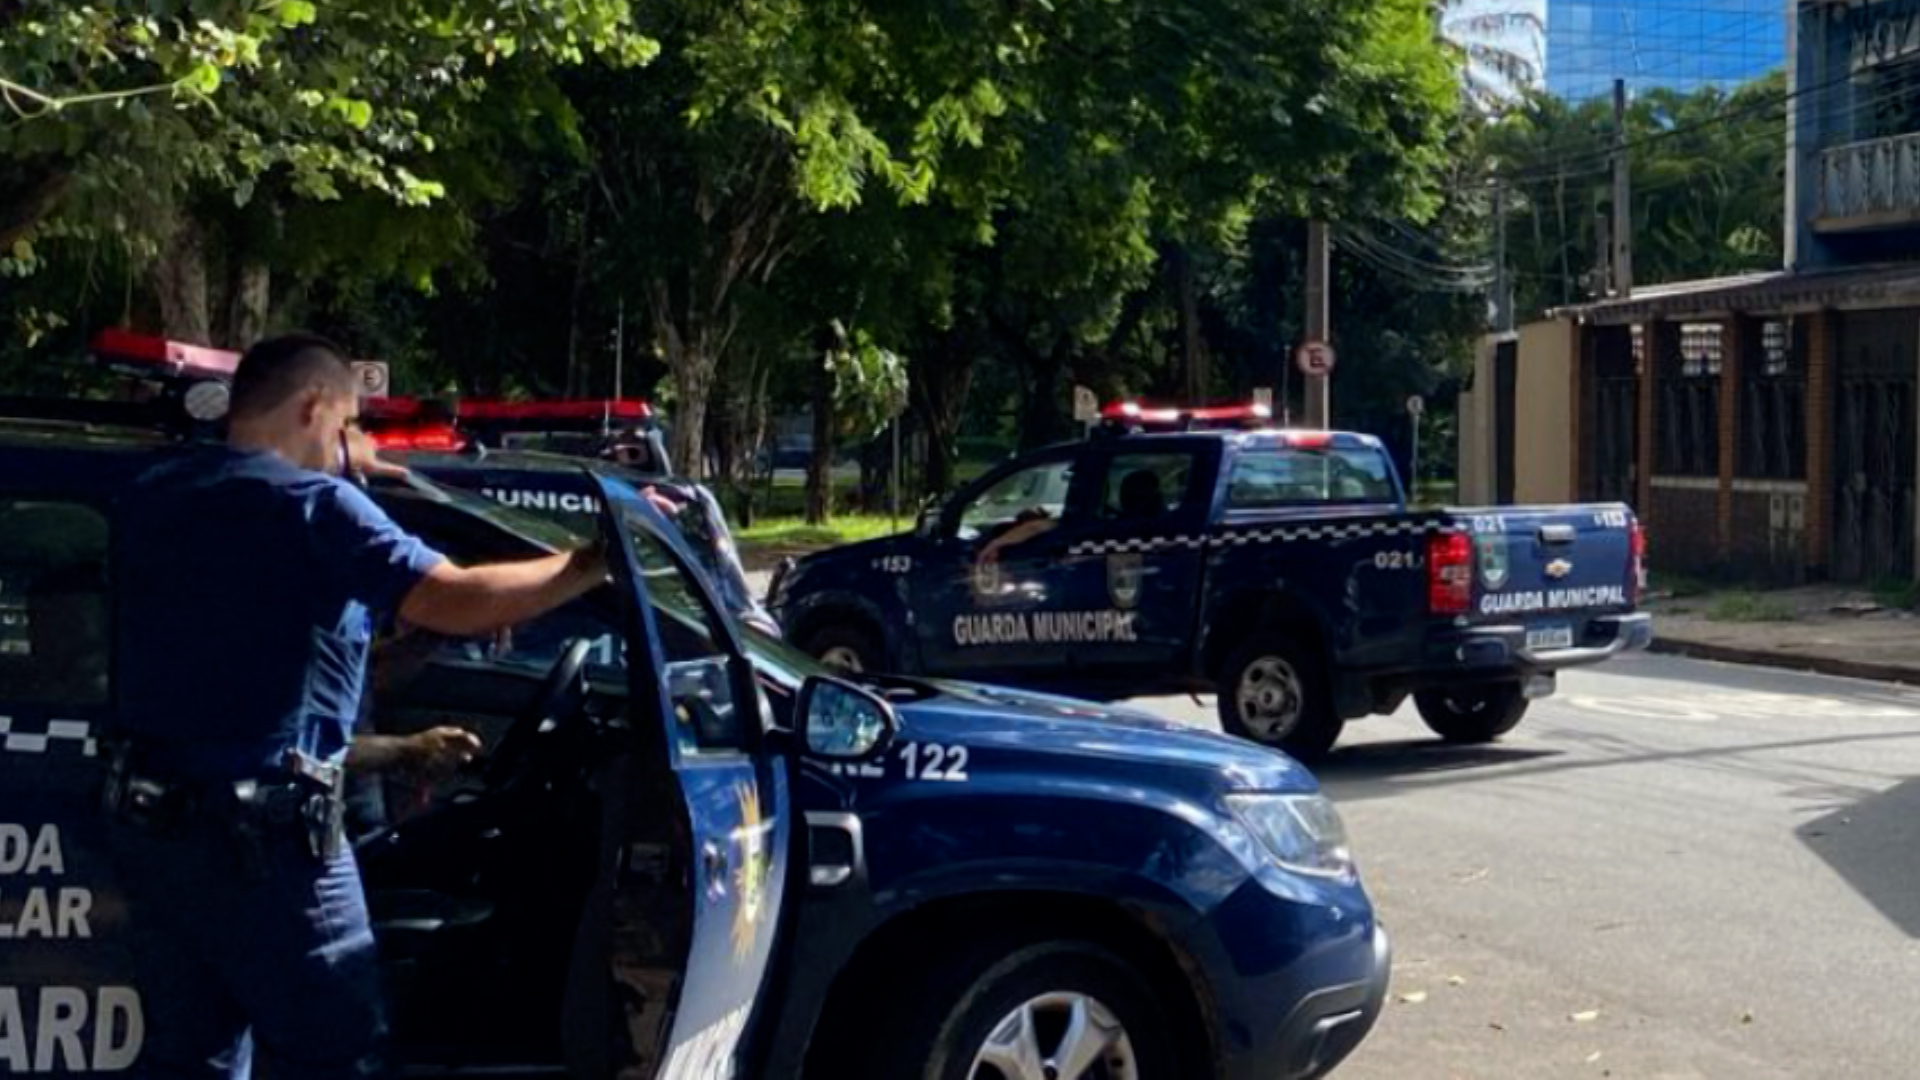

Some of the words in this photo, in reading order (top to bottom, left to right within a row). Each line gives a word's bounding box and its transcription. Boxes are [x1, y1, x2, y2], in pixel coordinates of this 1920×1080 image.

[481, 487, 601, 514] UNICI
[1374, 550, 1414, 570] 021
[1480, 590, 1544, 614] GUARDA
[1547, 585, 1627, 608] MUNICIPAL
[954, 614, 1029, 646] GUARDA
[1032, 610, 1137, 642] MUNICIPAL
[899, 741, 969, 781] 122
